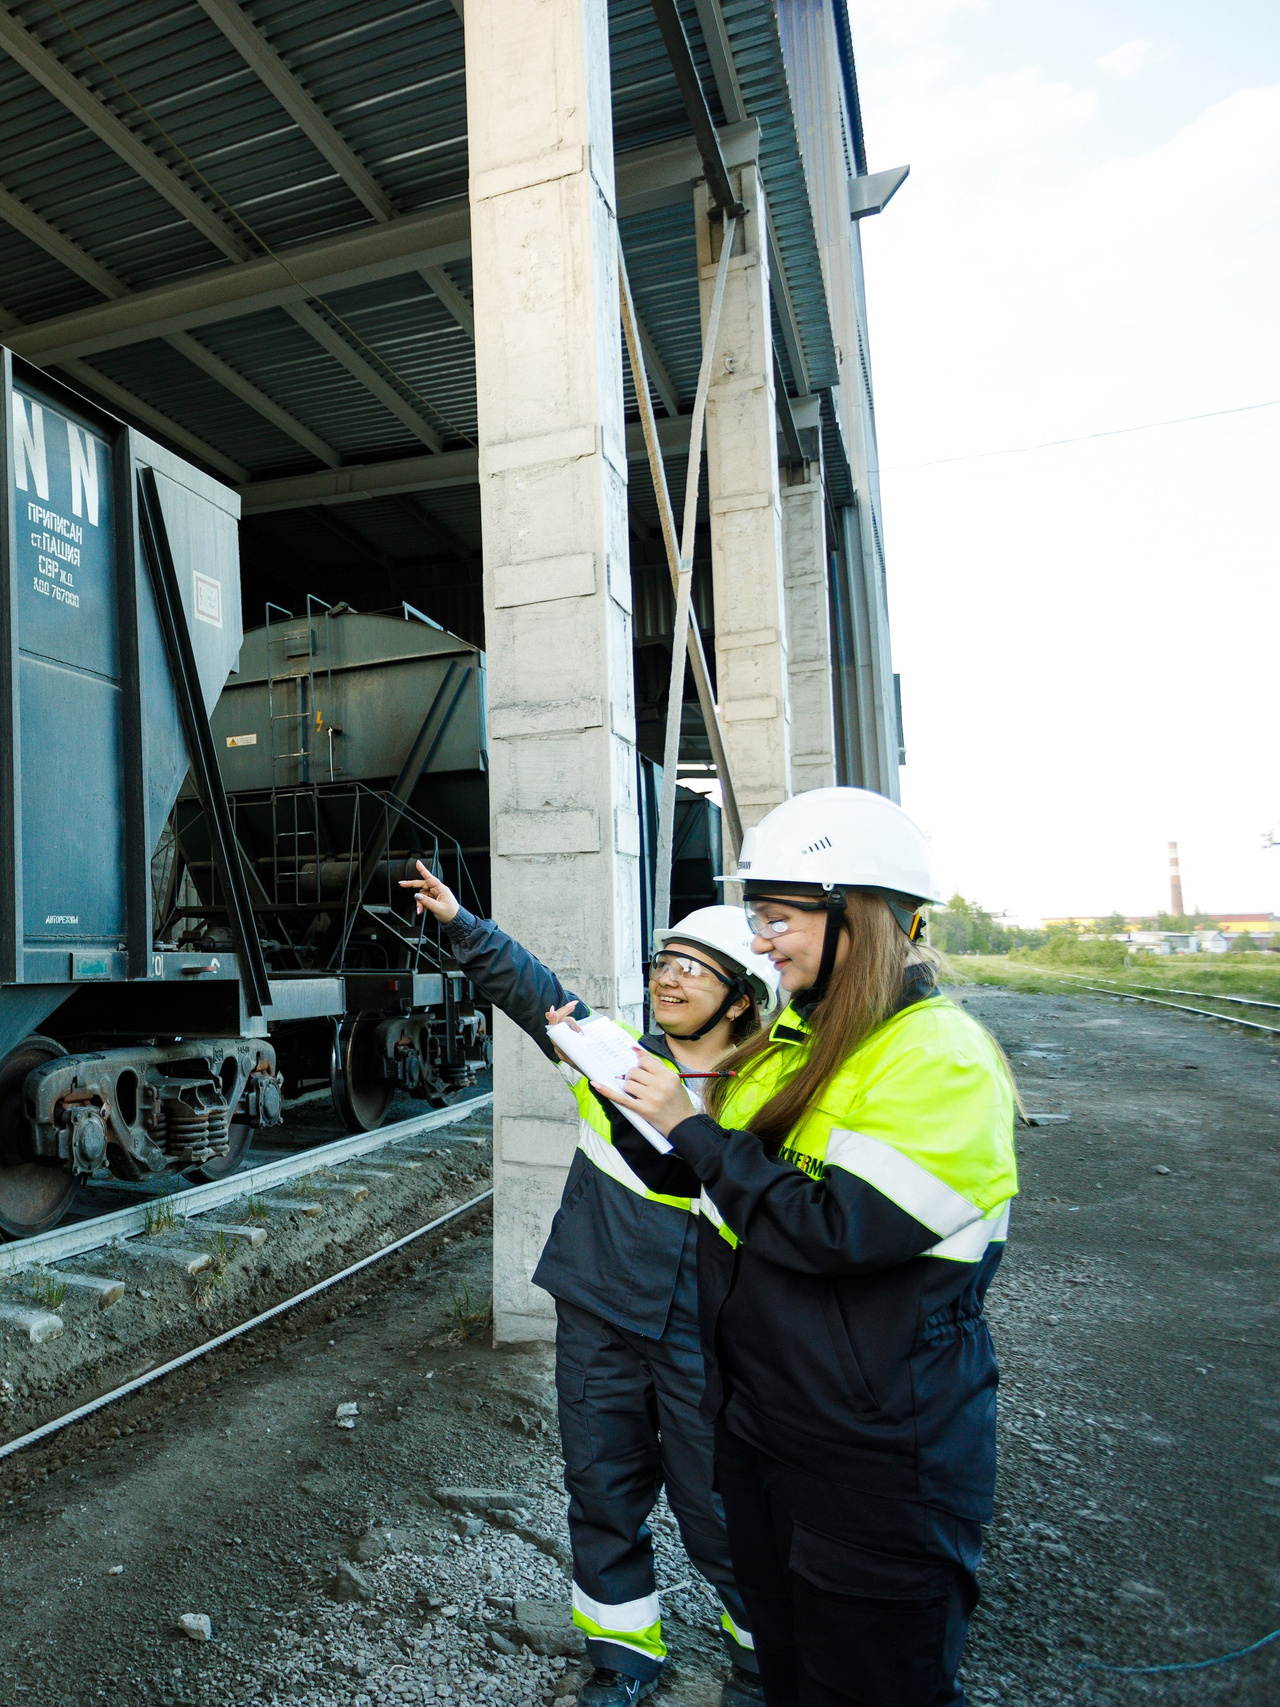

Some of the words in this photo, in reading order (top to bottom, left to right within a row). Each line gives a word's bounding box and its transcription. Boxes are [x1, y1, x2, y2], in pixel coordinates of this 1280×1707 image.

[28, 501, 83, 545] ПРИПИСАН
[38, 554, 59, 579] СВР
[51, 584, 80, 608] 767000
